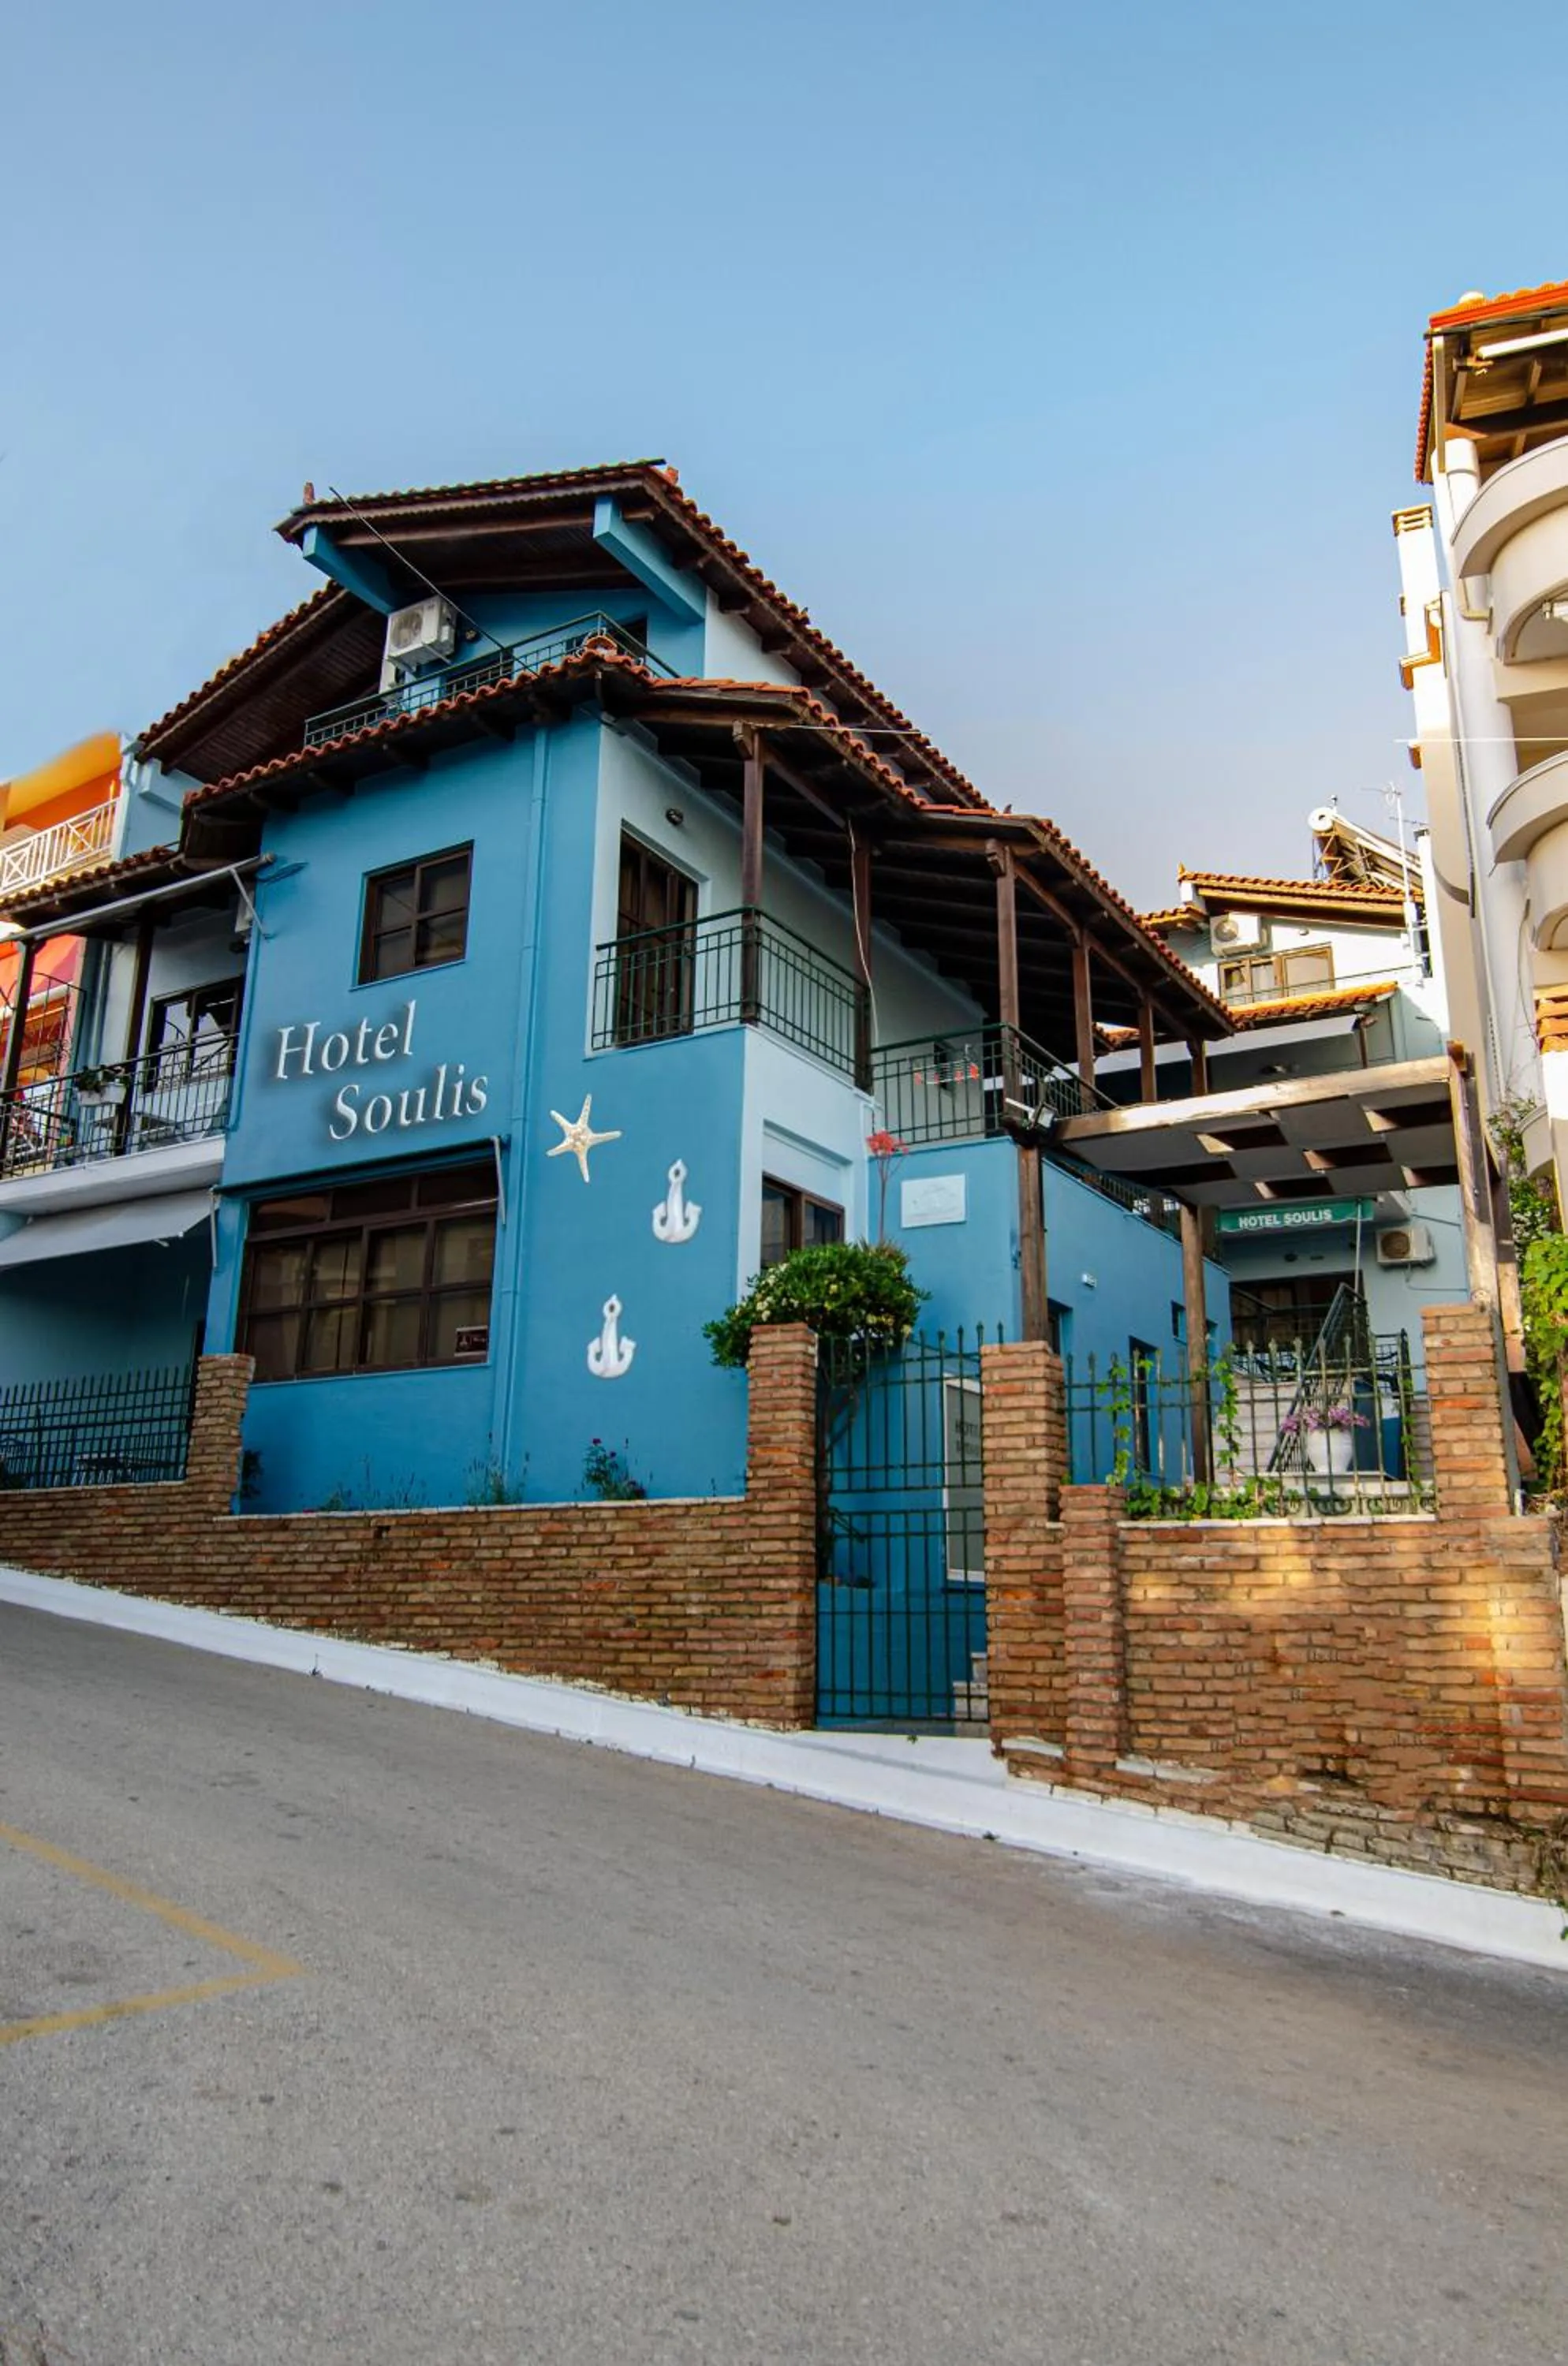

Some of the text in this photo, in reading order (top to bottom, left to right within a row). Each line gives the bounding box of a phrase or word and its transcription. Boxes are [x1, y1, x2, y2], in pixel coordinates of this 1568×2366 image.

[276, 999, 416, 1079] Hotel
[328, 1063, 488, 1140] Soulis
[1238, 1209, 1332, 1230] HOTEL SOULIS
